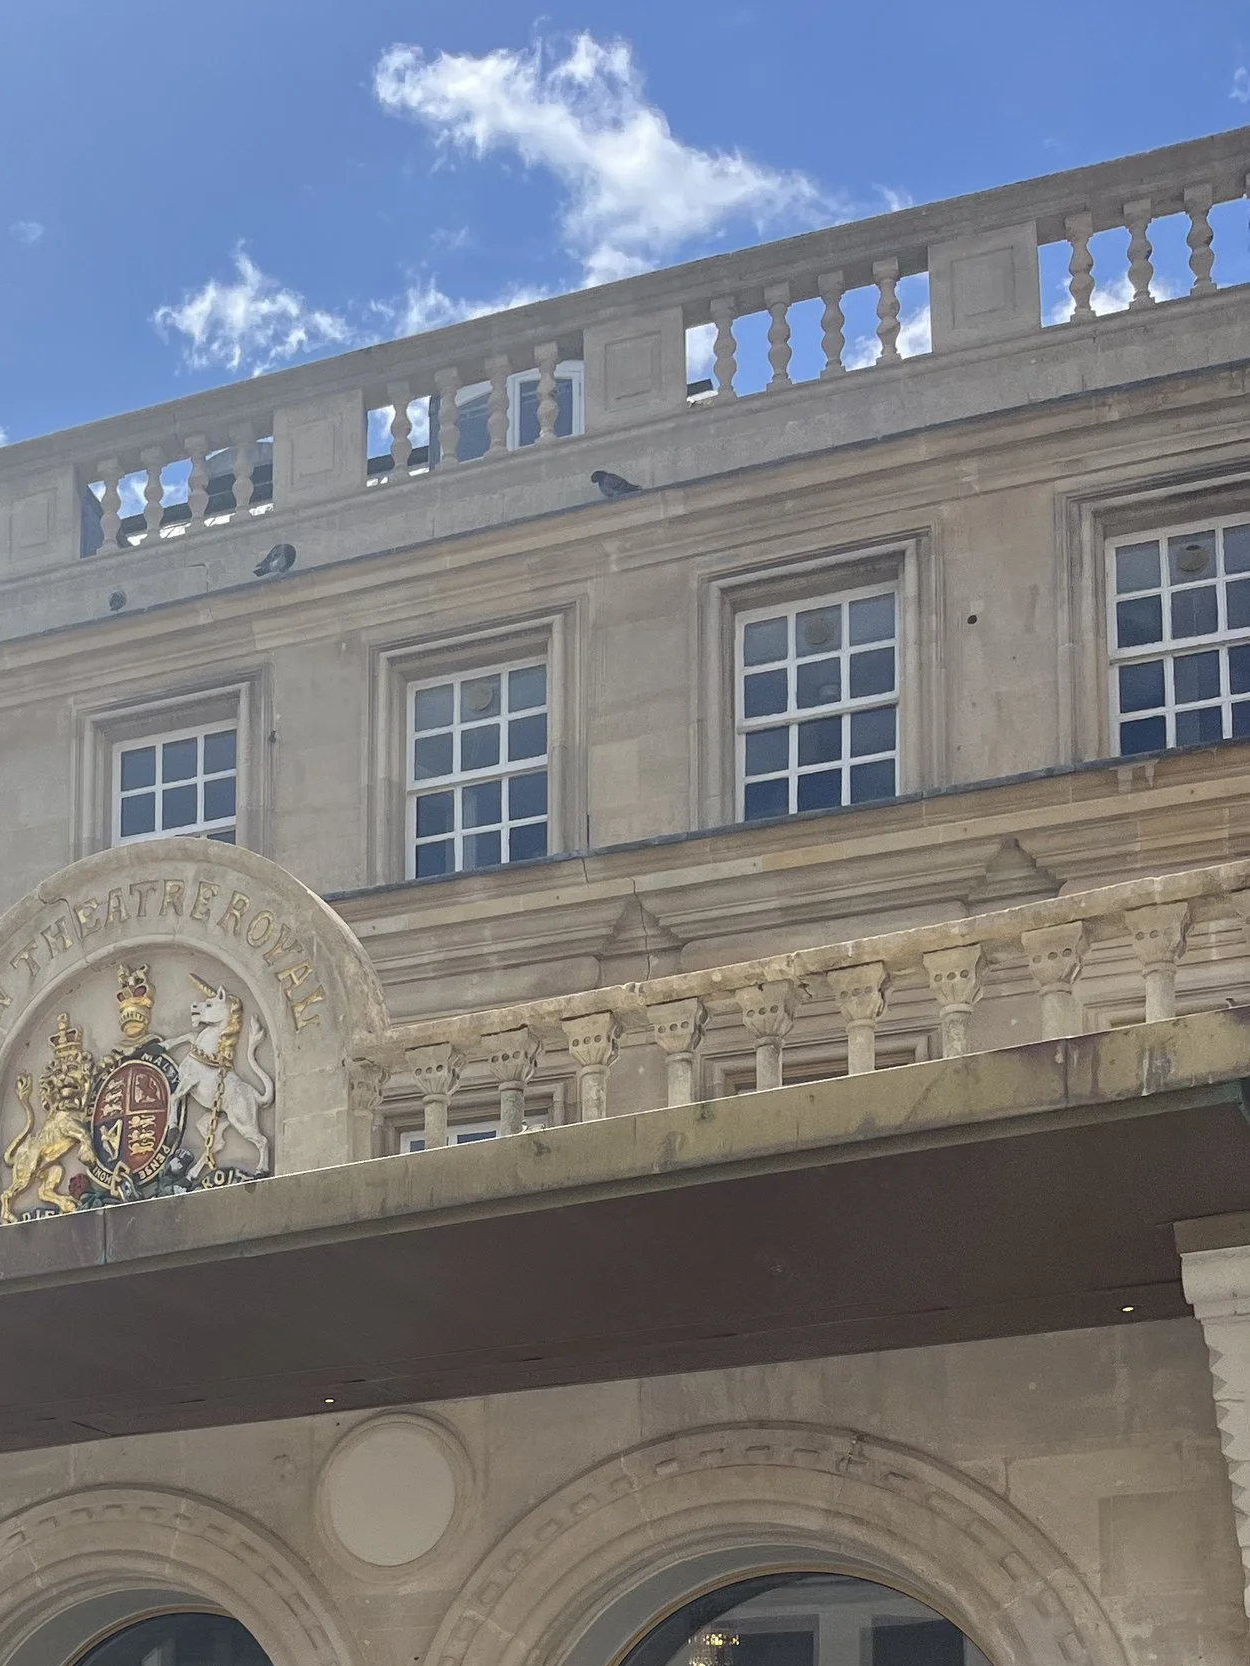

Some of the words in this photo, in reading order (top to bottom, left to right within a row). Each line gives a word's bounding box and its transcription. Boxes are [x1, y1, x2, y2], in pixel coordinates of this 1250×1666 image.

[9, 878, 221, 978] THEATRE
[216, 889, 328, 1035] ROYAL
[137, 1144, 171, 1180] PENSE
